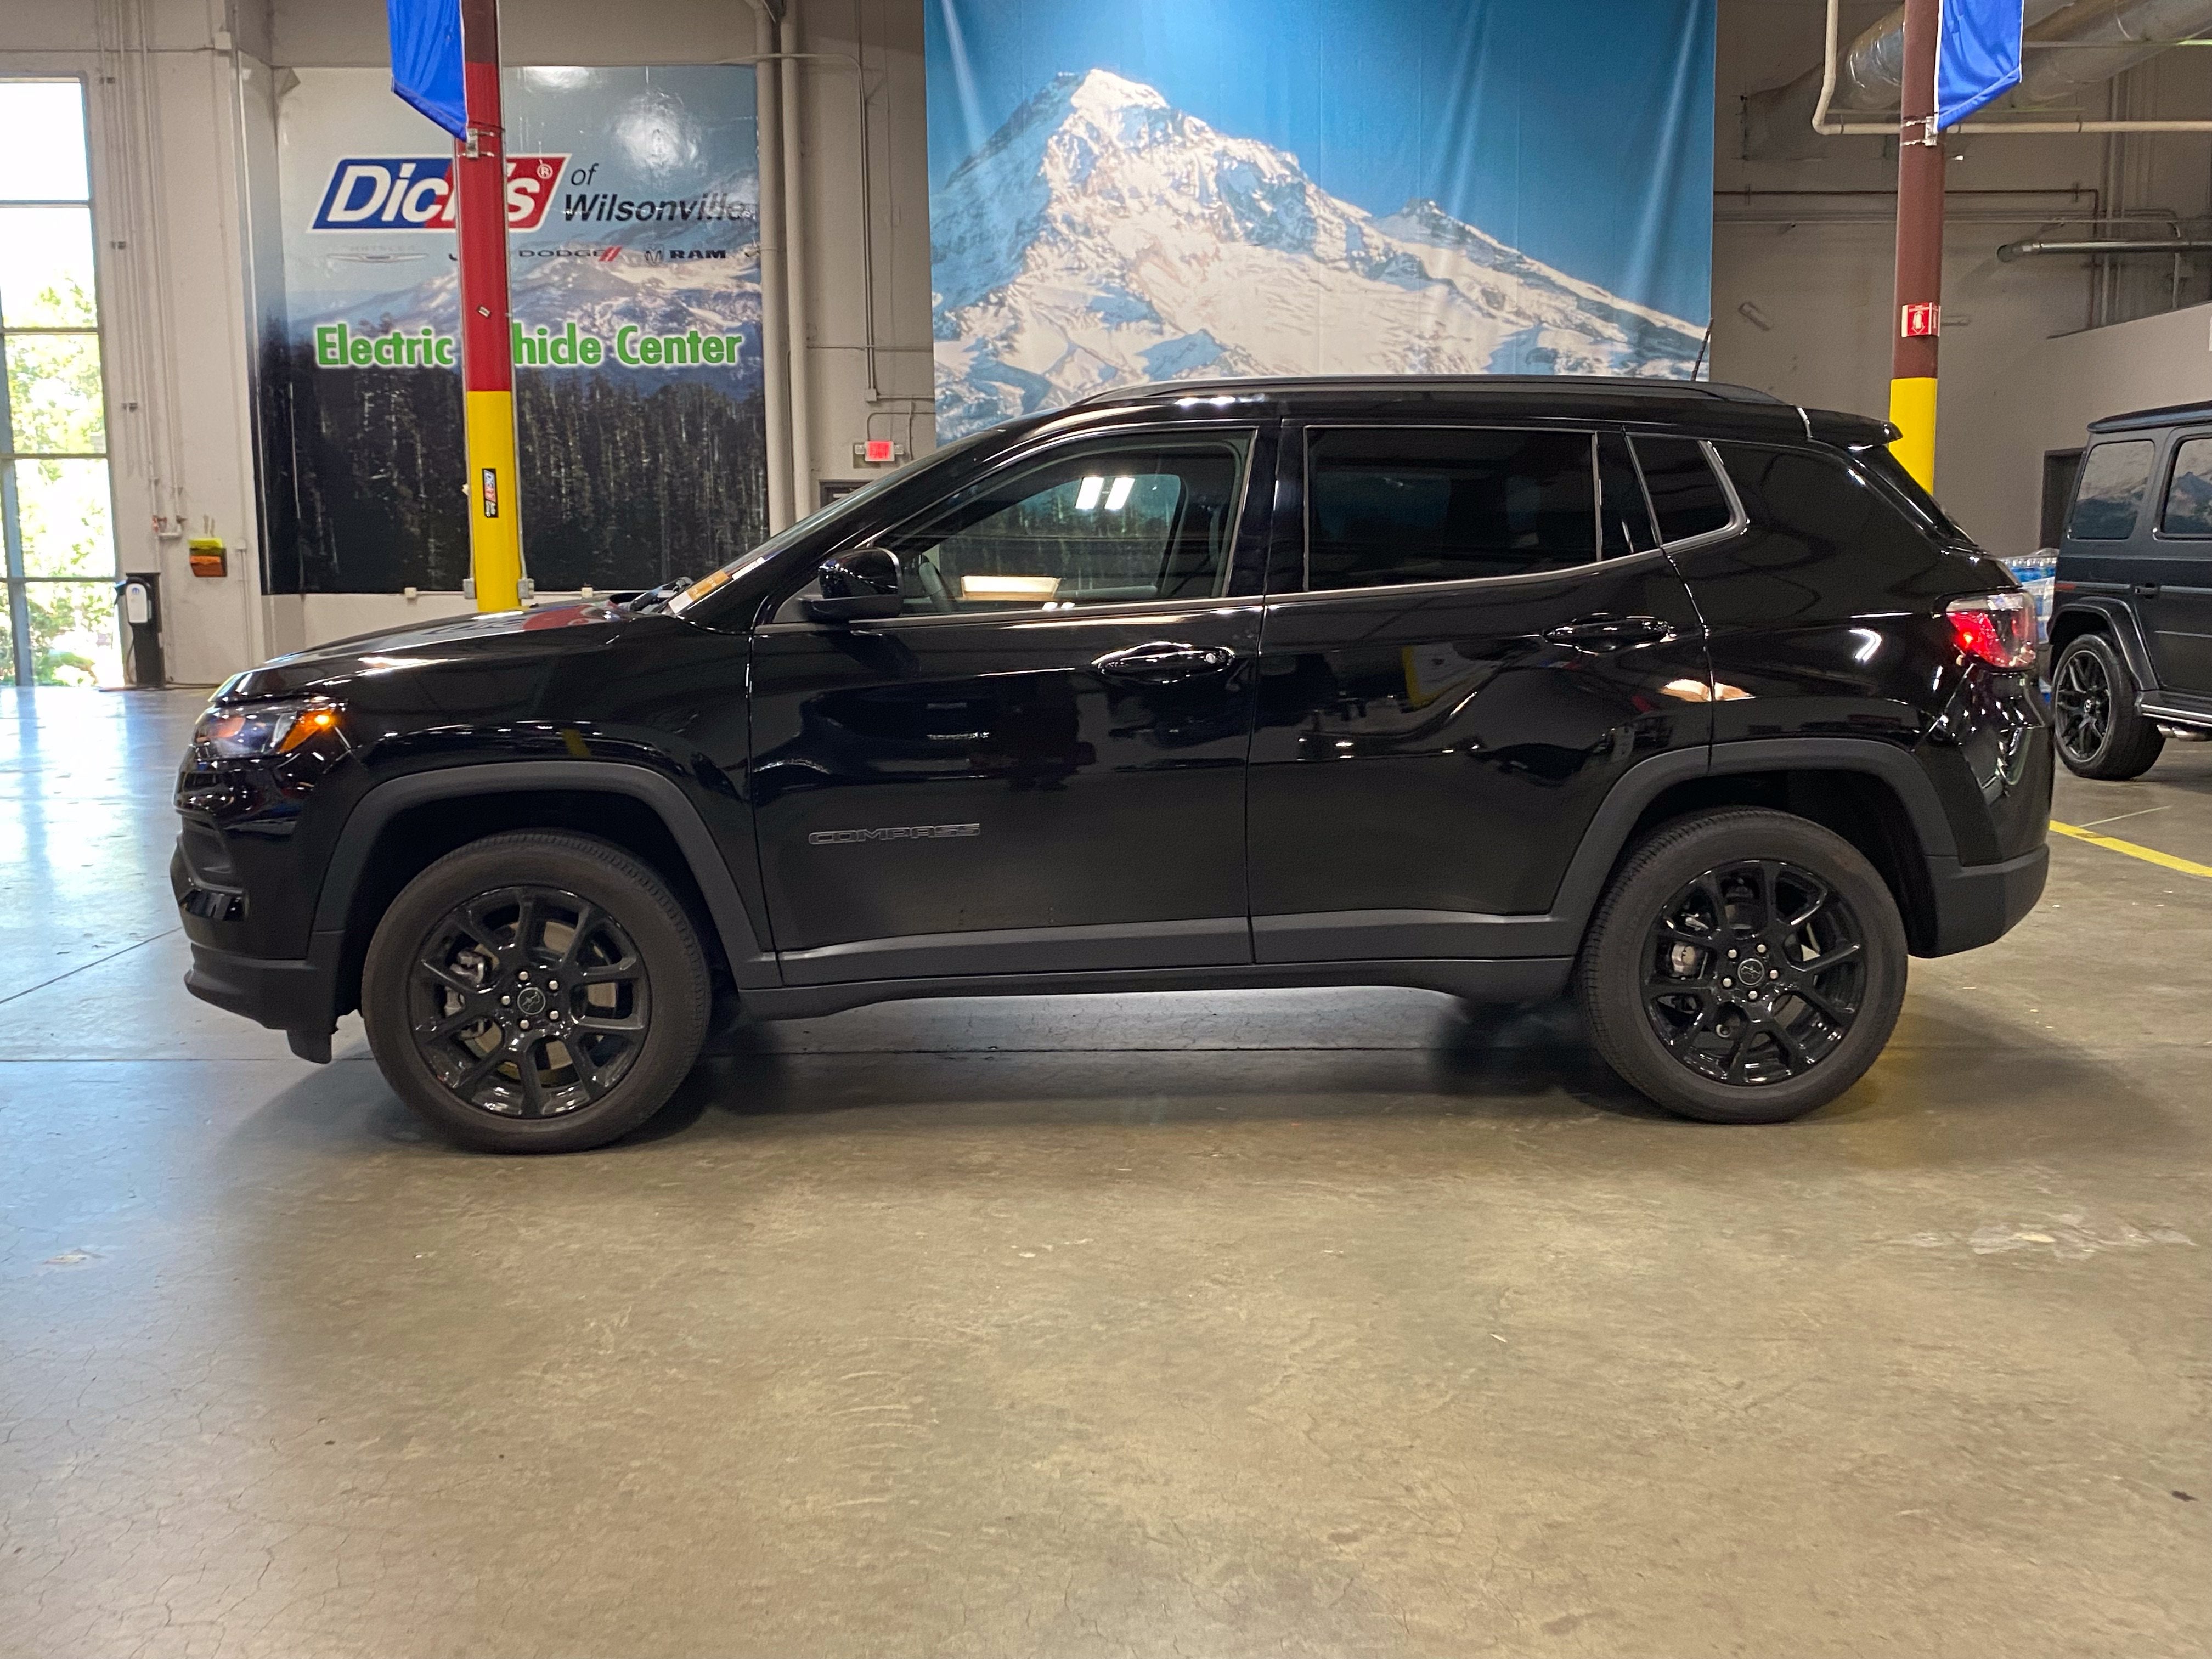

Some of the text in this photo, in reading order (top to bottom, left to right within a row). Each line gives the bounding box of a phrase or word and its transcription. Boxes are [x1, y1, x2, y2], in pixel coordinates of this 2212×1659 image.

[571, 162, 599, 185] of
[518, 249, 605, 257] DODGE
[670, 249, 726, 259] RAM
[316, 323, 743, 366] Electric hicle Center
[809, 823, 980, 844] COMPASS
